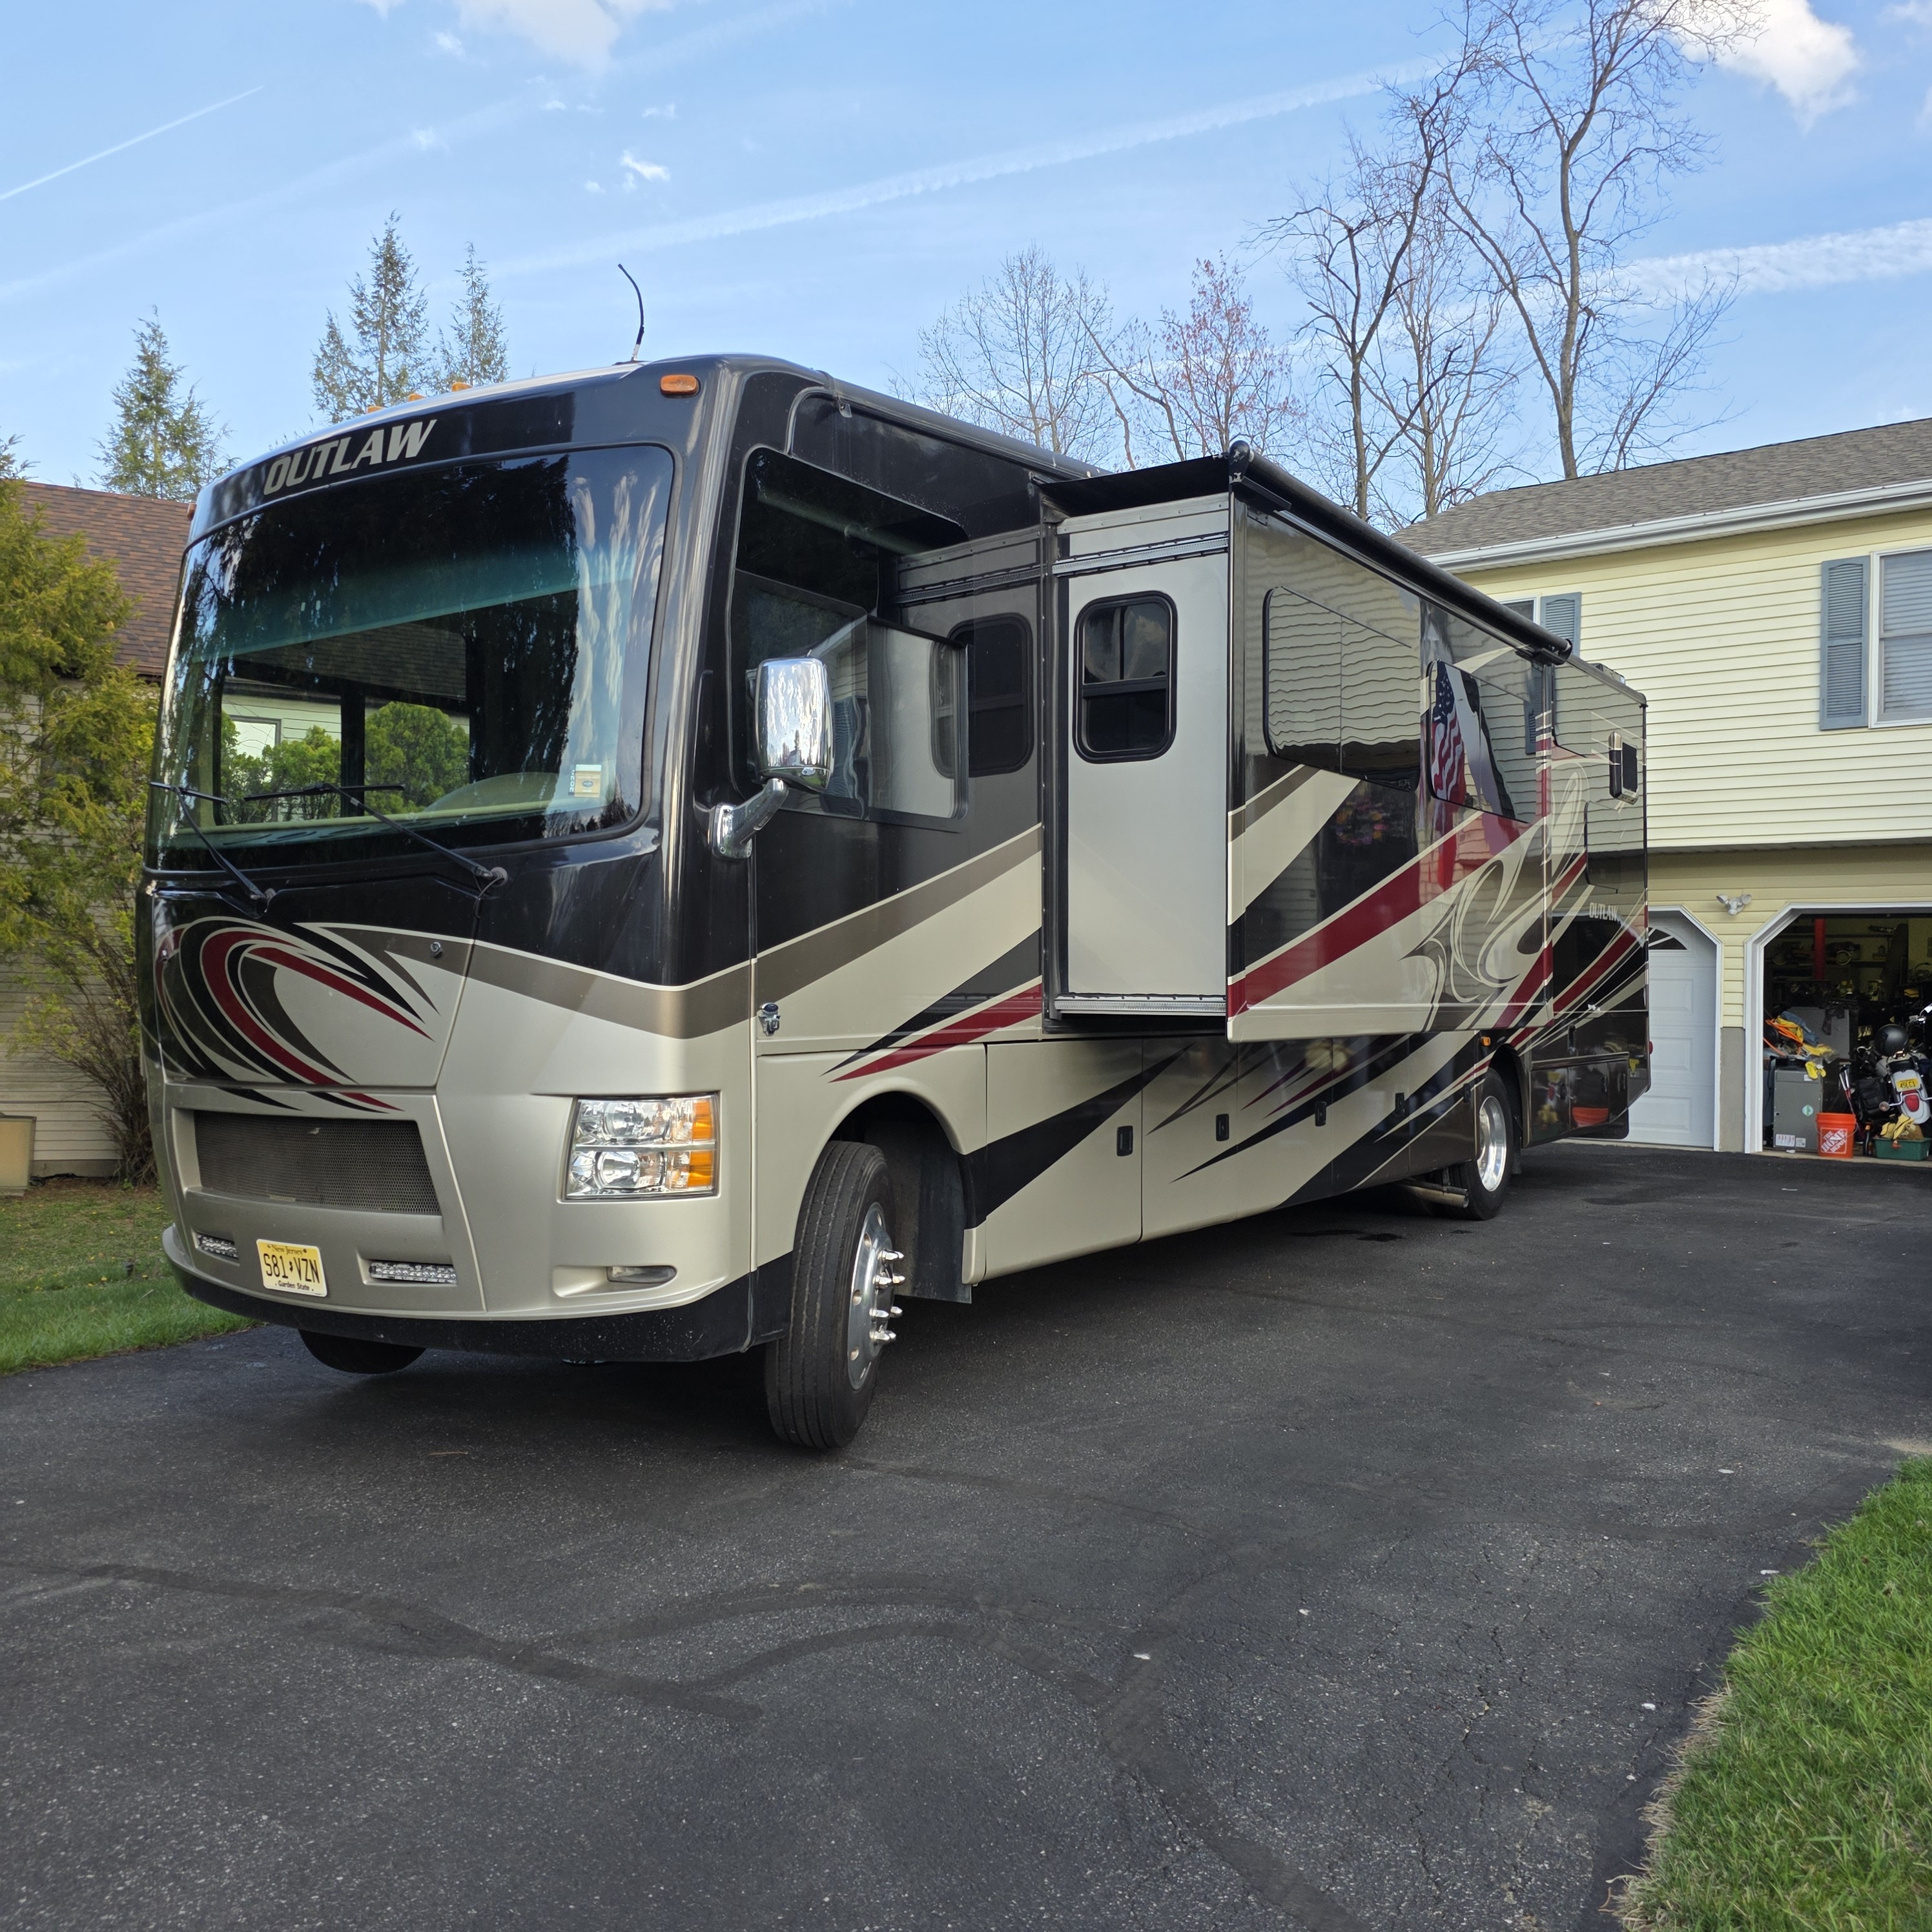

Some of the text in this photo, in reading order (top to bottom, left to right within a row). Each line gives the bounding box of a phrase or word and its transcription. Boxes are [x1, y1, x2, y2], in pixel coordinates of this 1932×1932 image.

[263, 419, 437, 495] OUTLAW
[1589, 902, 1618, 921] OUTLAW
[285, 1246, 302, 1257] Jersey
[297, 1282, 309, 1291] State
